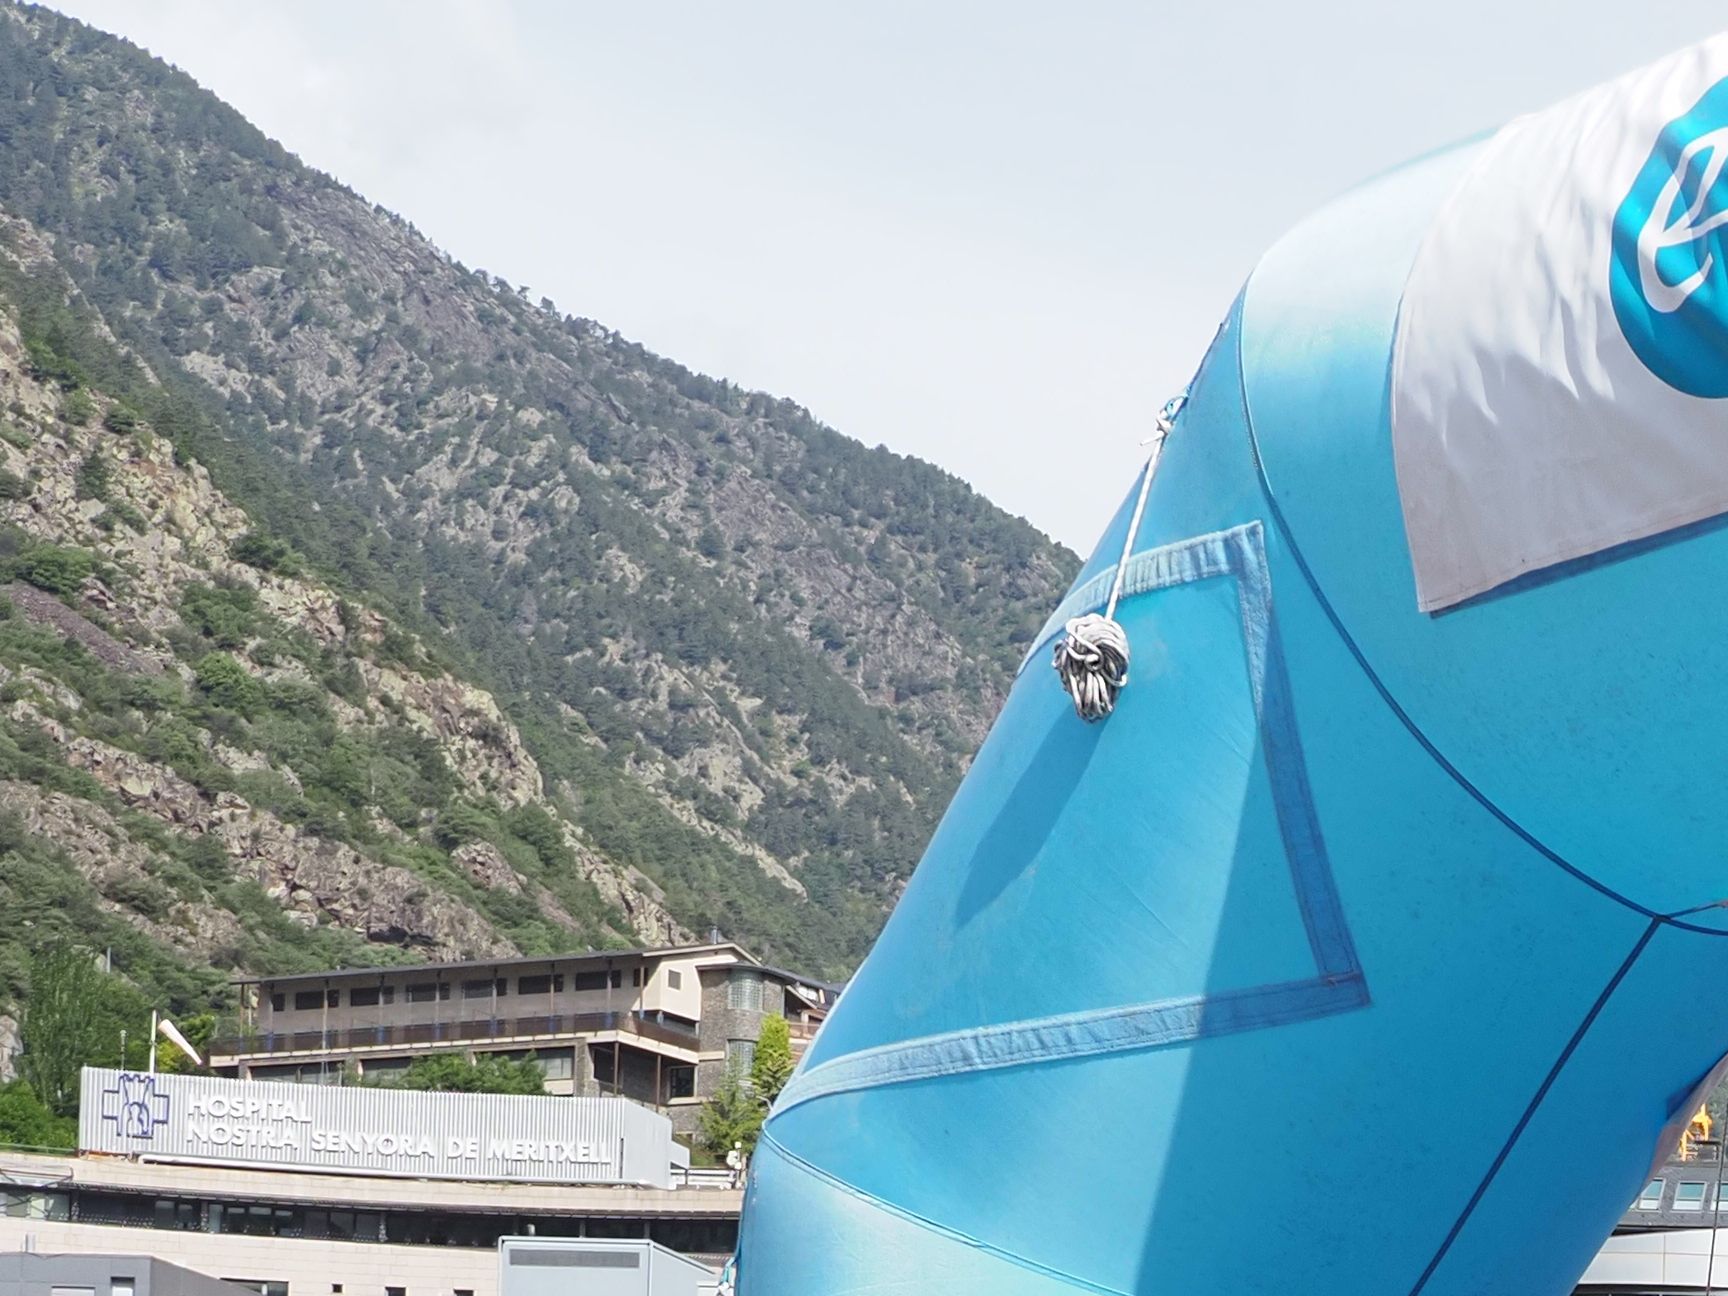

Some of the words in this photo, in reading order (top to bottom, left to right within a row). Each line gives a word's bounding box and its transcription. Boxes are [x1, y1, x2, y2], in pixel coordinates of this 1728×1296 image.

[188, 1096, 312, 1124] HOSPITAL
[186, 1122, 297, 1151] NOSTRA
[311, 1130, 433, 1159] SENYORA
[446, 1137, 478, 1160] DE
[487, 1140, 612, 1165] MERITXELL
